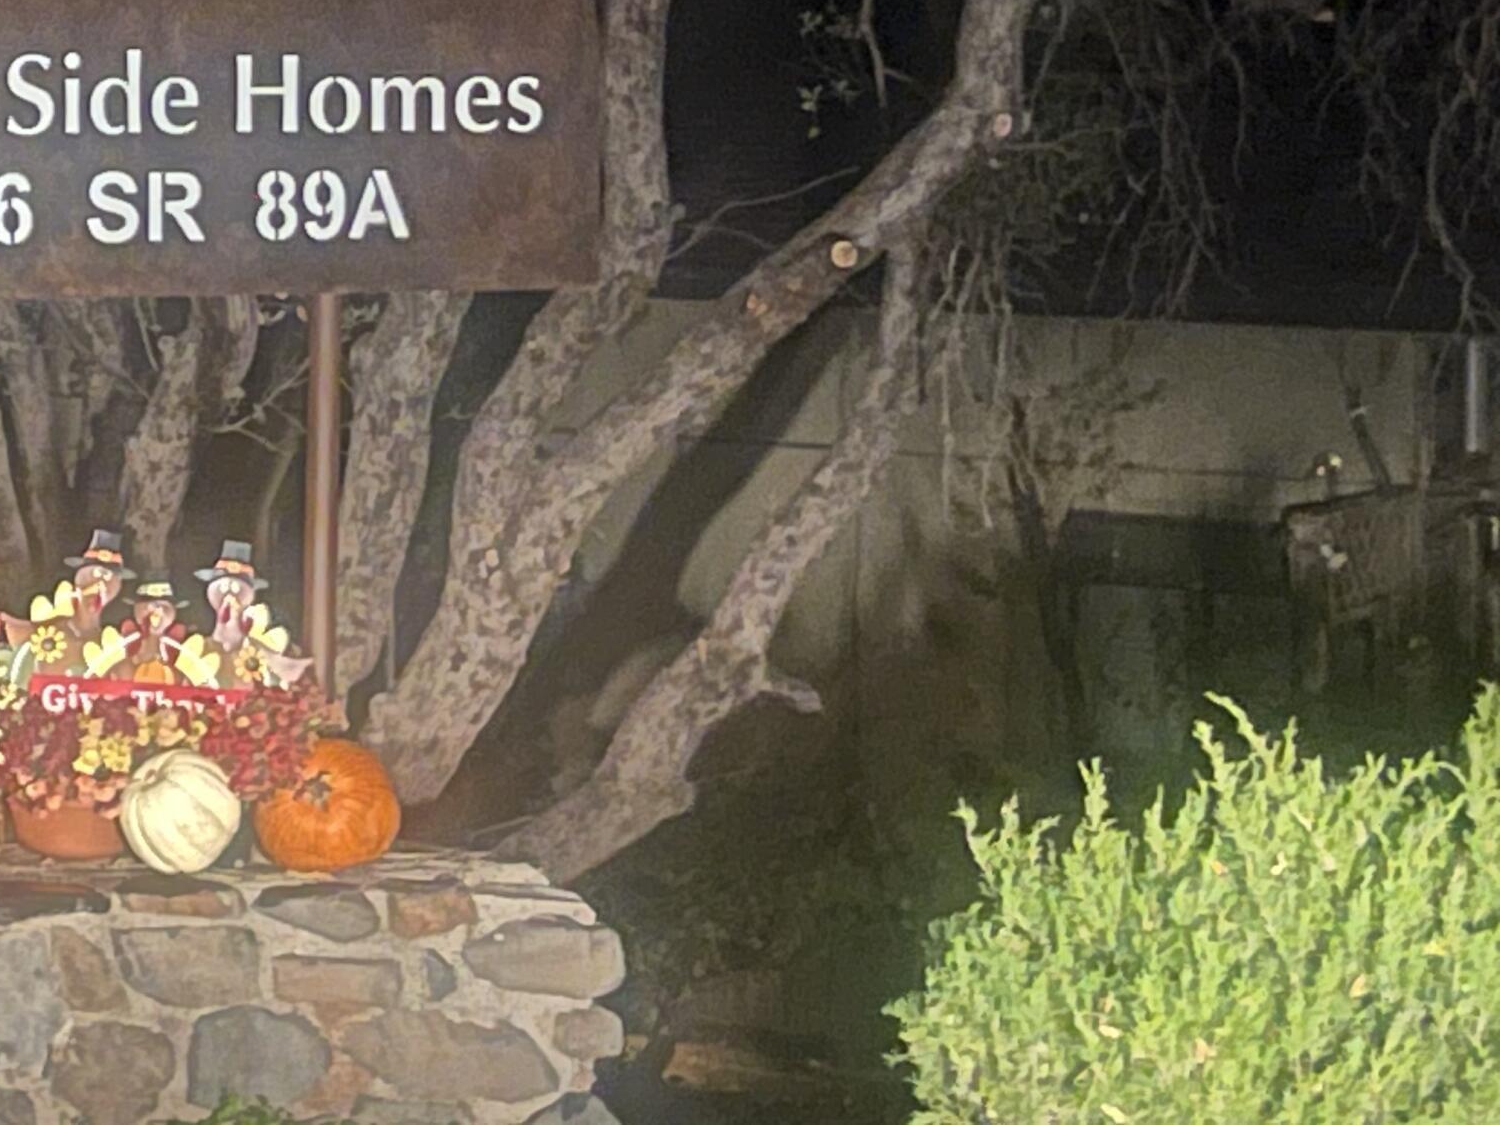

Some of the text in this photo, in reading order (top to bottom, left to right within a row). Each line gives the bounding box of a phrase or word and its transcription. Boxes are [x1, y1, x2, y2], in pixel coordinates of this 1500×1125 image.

[5, 48, 200, 136] Side
[235, 52, 544, 135] Homes
[85, 169, 206, 244] SR
[255, 168, 411, 242] 89A
[41, 683, 104, 714] Giv
